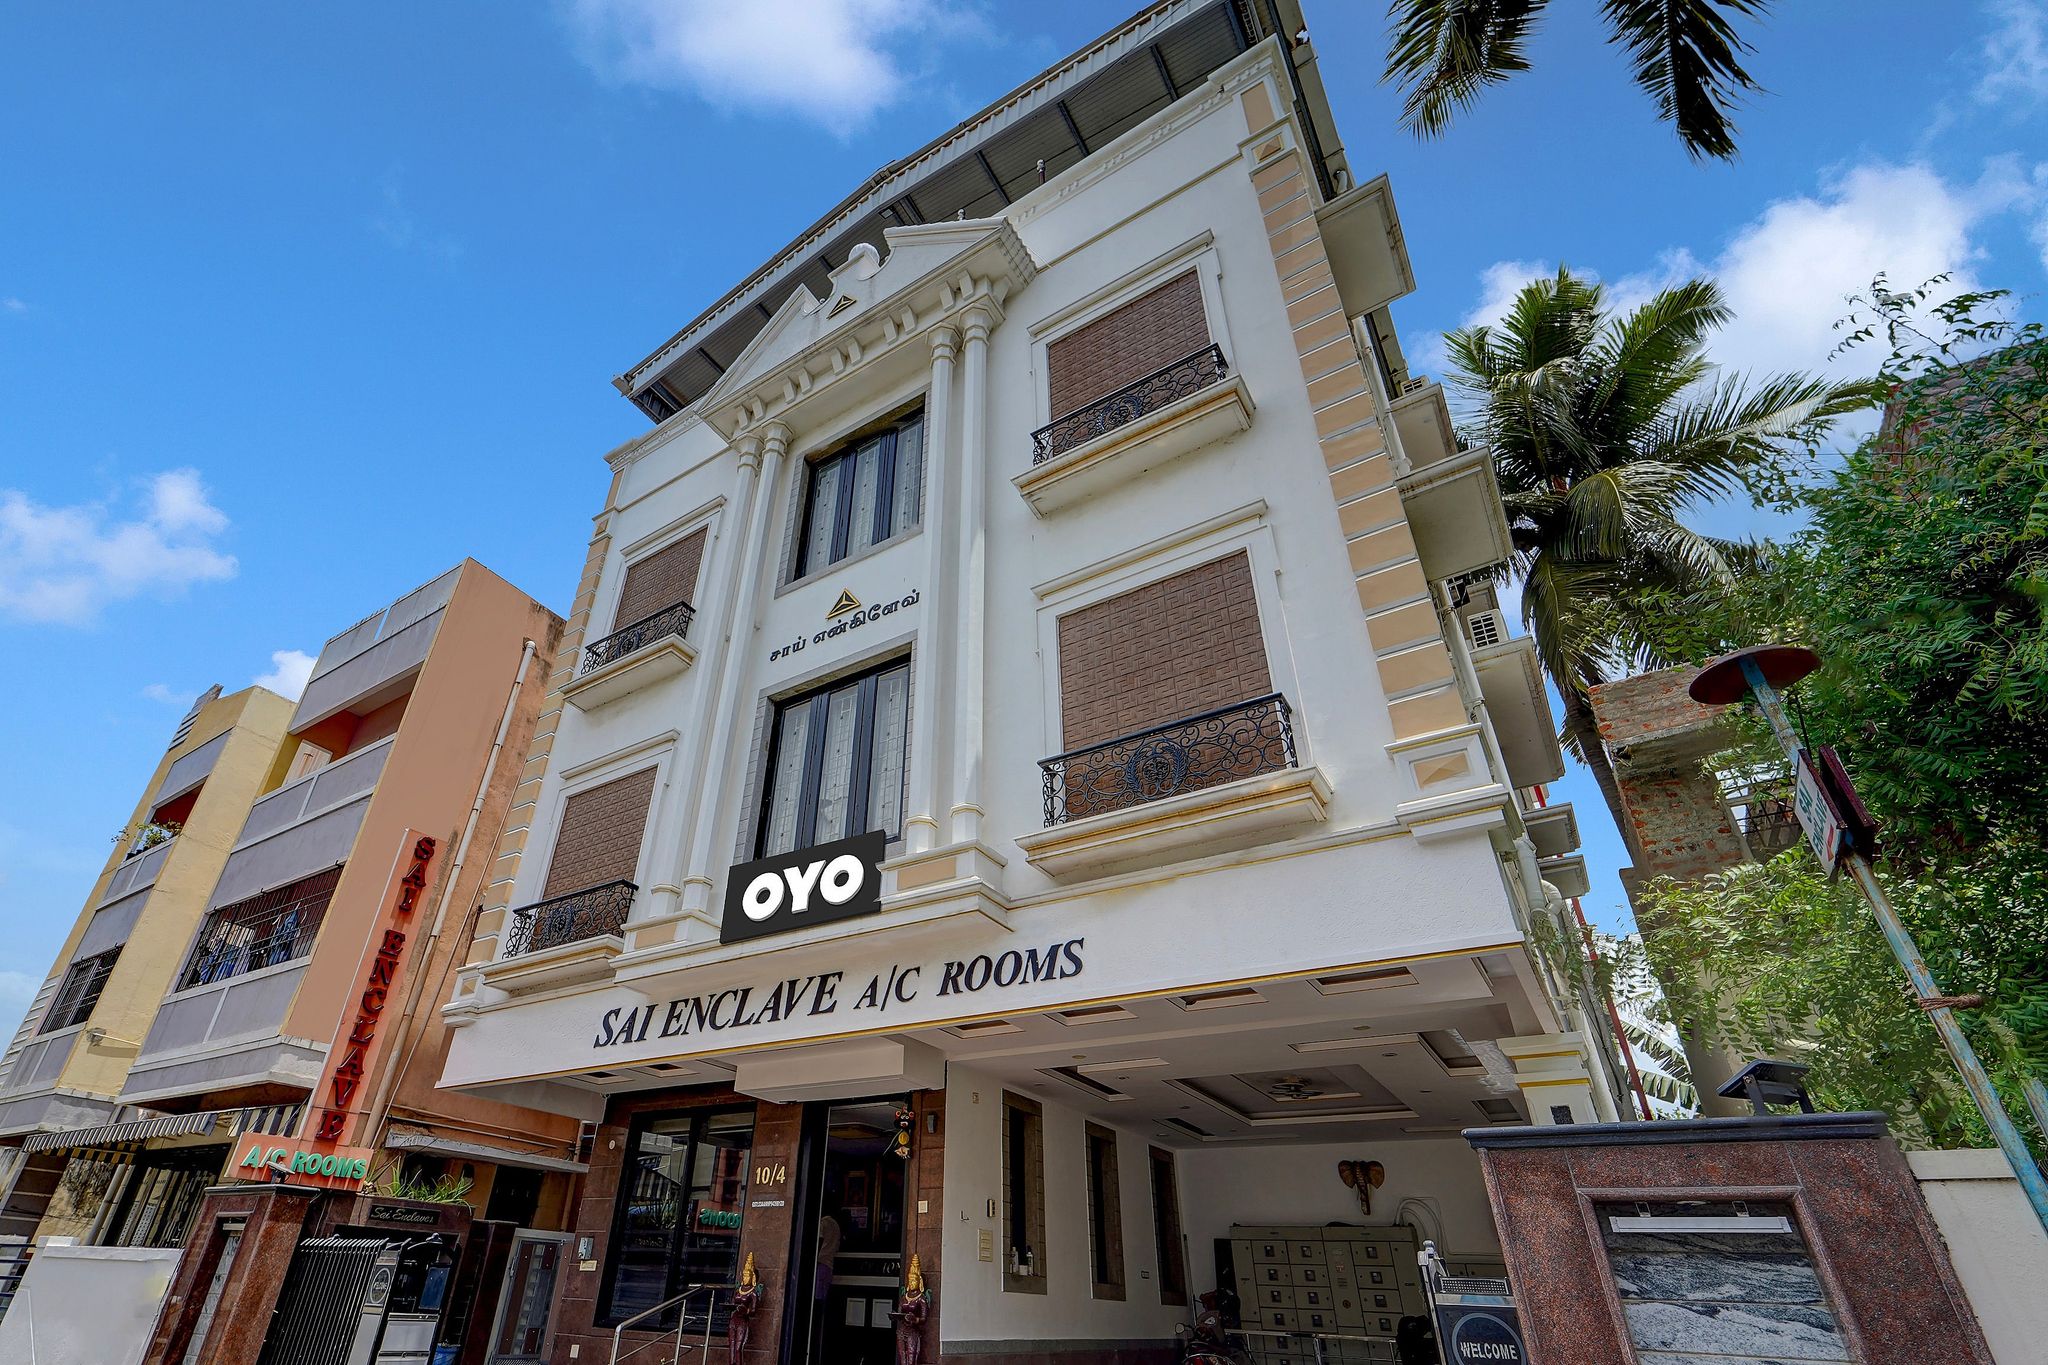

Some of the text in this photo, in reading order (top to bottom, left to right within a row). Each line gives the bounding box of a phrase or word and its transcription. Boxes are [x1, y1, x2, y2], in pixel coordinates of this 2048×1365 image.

[769, 635, 807, 662] சாய்
[742, 854, 865, 922] OYO
[315, 836, 437, 1141] SAI ENCLAVE
[593, 937, 1085, 1049] SAI ENCLAVE A/C ROOMS
[290, 1150, 367, 1180] ROOMS
[755, 1163, 786, 1187] 10/4
[371, 1206, 392, 1220] Sai
[1460, 1341, 1519, 1360] WELCOME
